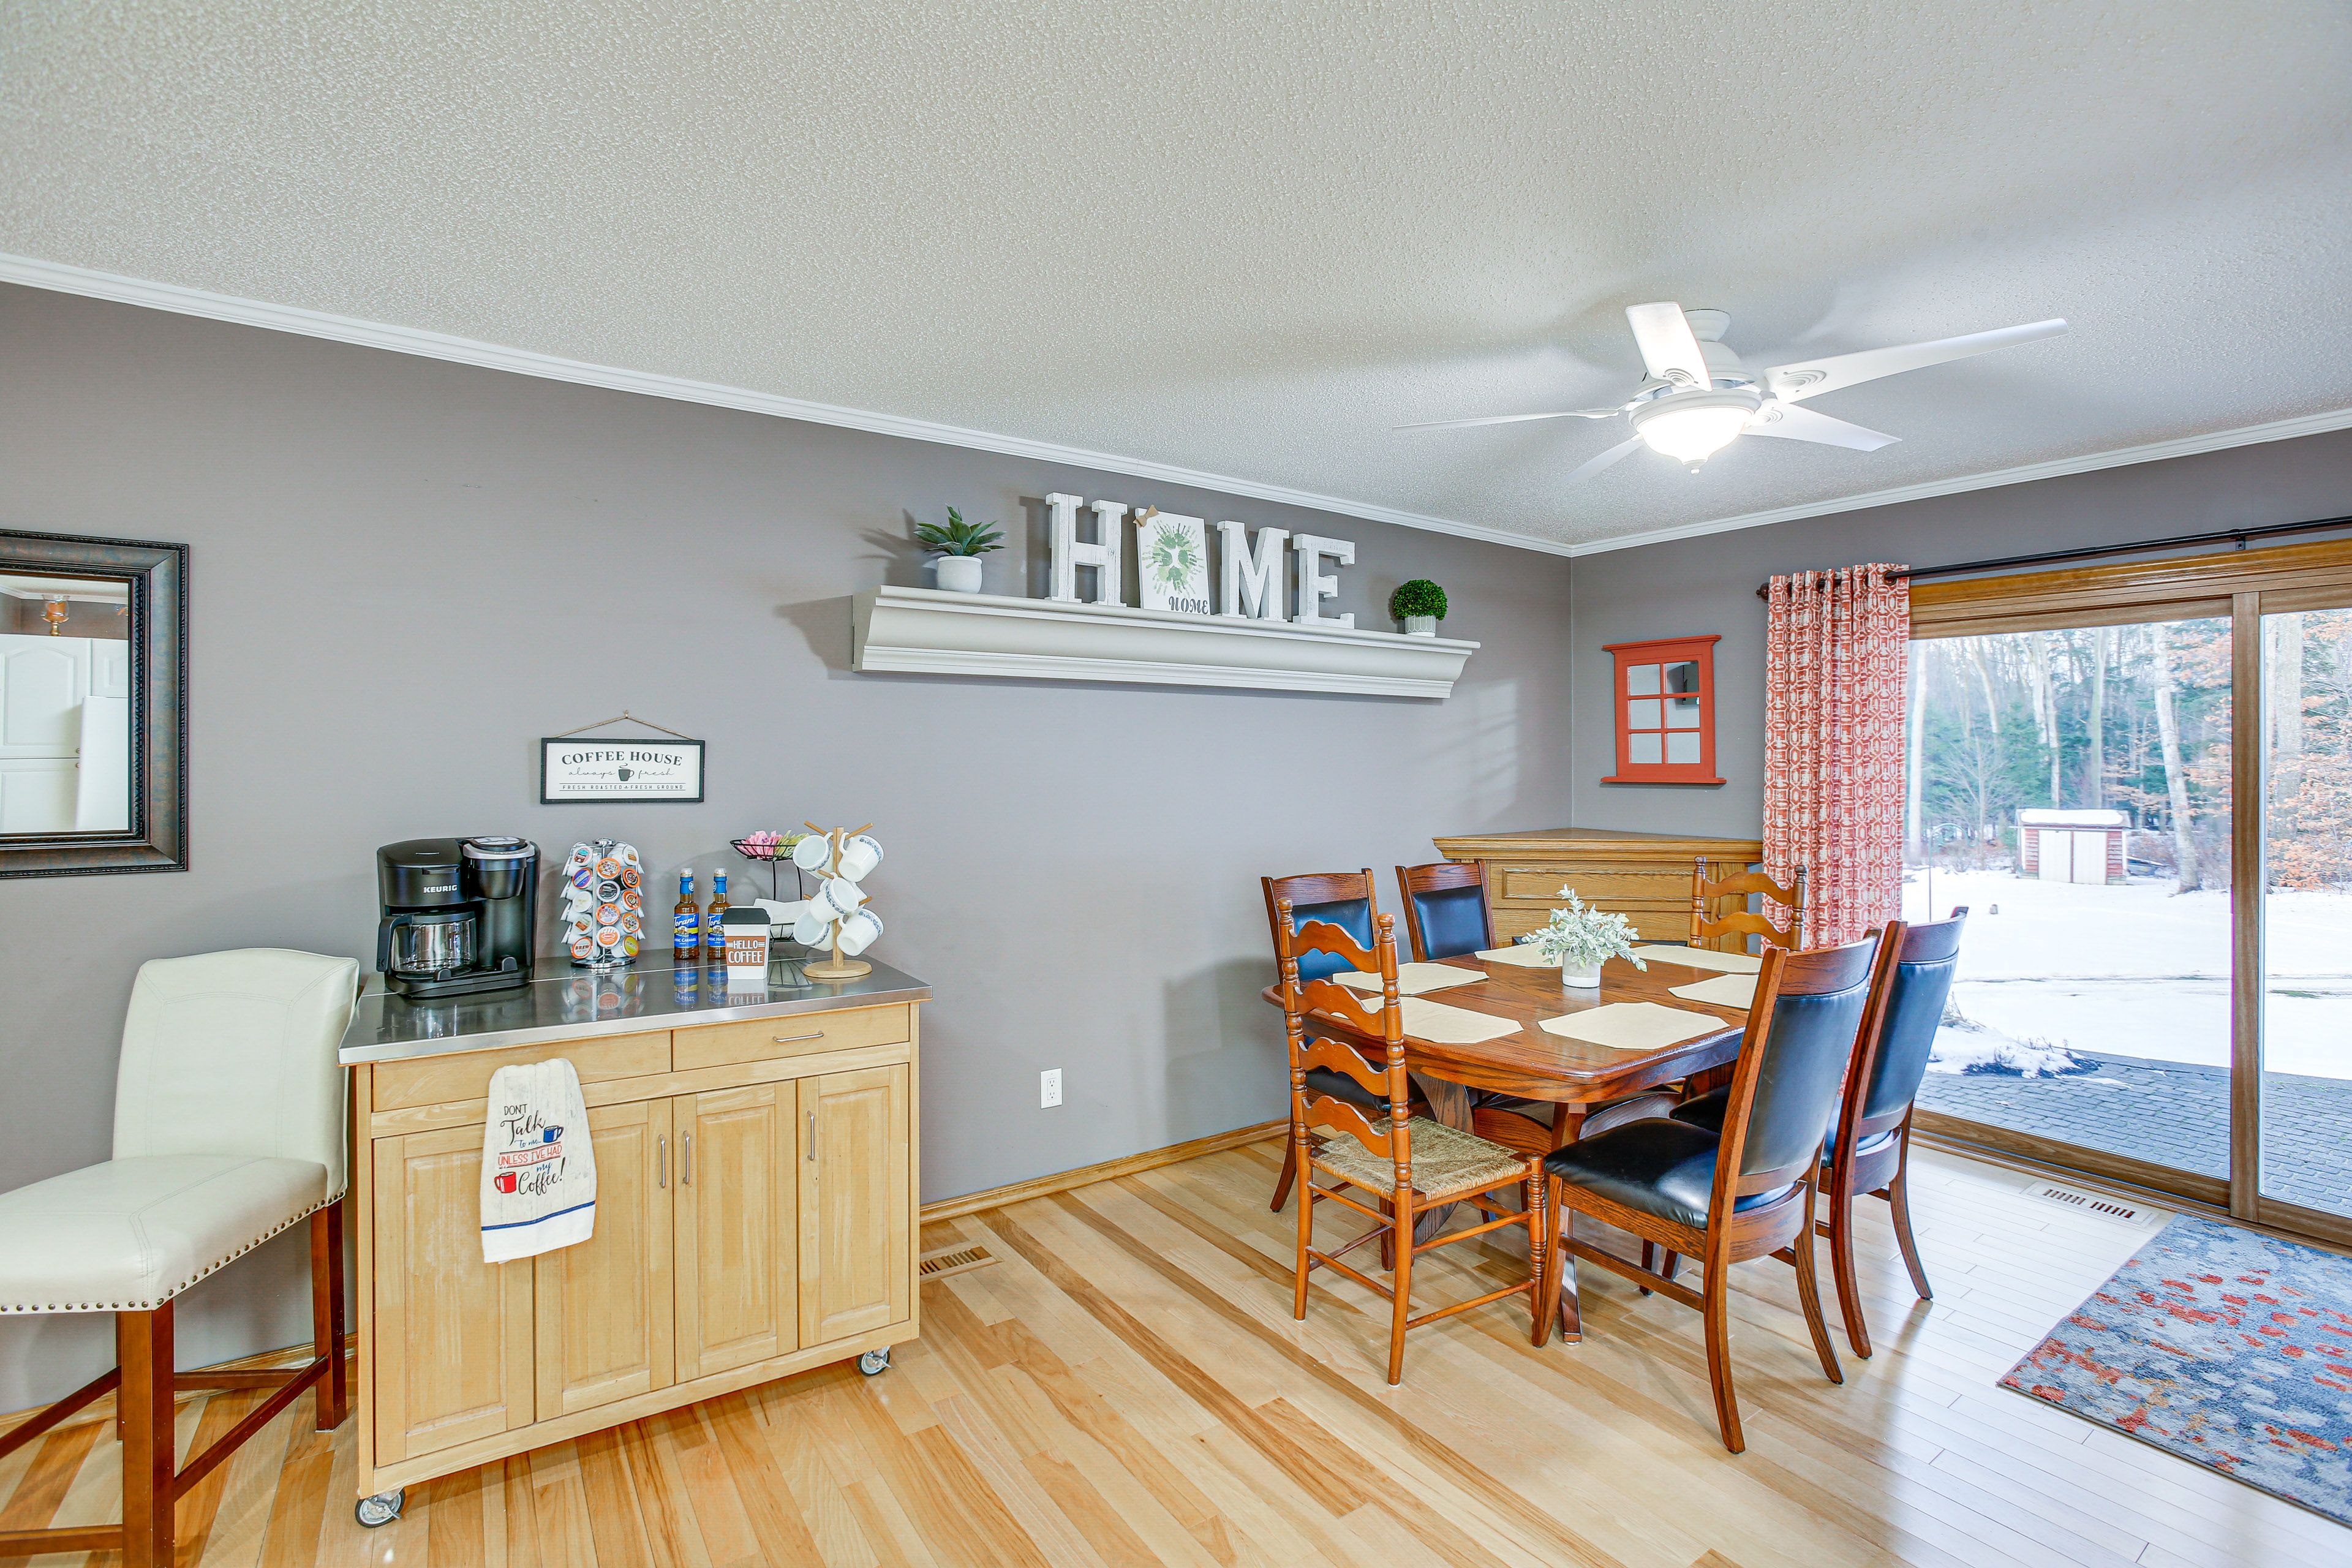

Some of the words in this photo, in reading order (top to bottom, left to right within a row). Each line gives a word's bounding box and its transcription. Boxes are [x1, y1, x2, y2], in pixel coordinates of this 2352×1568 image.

[1168, 595, 1209, 614] HOME
[562, 751, 625, 765] COFFEE
[630, 751, 683, 766] HOUSE
[568, 767, 616, 779] always
[638, 768, 674, 779] fresh
[423, 884, 458, 893] KEURIG
[674, 914, 696, 929] Torani
[733, 940, 758, 949] HELLO
[728, 951, 764, 963] COFFEE
[500, 1110, 546, 1146] Talk
[498, 1152, 528, 1166] UNLESS
[530, 1148, 546, 1162] I'VE
[547, 1144, 562, 1158] HAD
[537, 1161, 553, 1174] my
[518, 1156, 566, 1196] Coffee!
